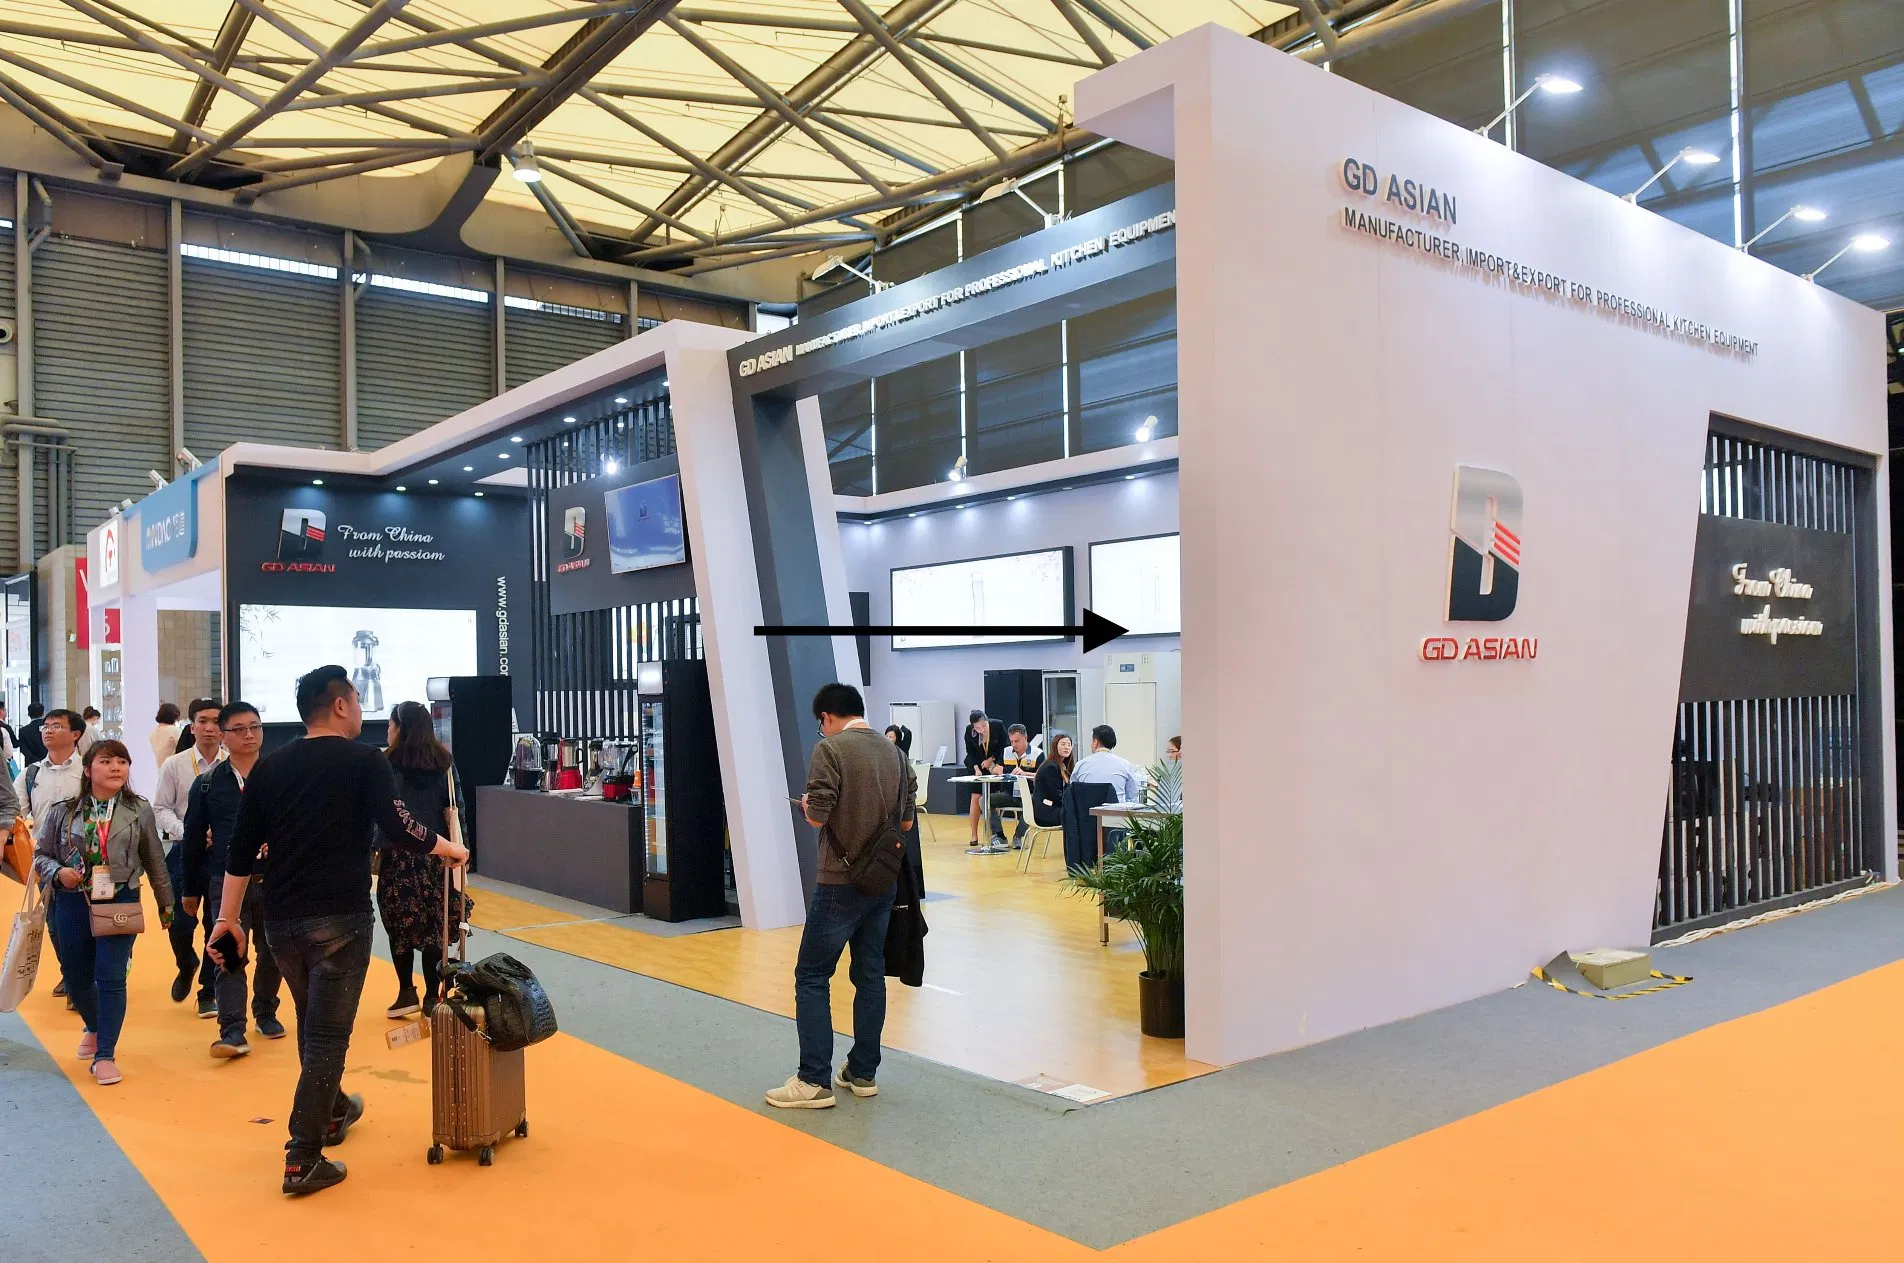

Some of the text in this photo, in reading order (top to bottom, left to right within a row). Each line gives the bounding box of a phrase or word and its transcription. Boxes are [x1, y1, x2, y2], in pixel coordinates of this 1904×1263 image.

[1343, 157, 1457, 225] GD ASIAN
[739, 358, 757, 377] GD
[757, 344, 794, 371] ASIAN
[940, 286, 964, 306] FOR
[964, 258, 1047, 297] PROFESSIONAL
[1050, 237, 1106, 268] KITCHEN
[1109, 209, 1176, 246] EQUIPMEN
[1571, 281, 1592, 304] FOR
[1596, 289, 1671, 329] PROFESSIONAL
[1673, 315, 1711, 342] KITCHEN
[1713, 329, 1759, 357] EQUIPMENT
[384, 526, 434, 543] China
[348, 544, 384, 559] with
[261, 562, 337, 573] GD ASIAN
[1421, 637, 1538, 661] GD ASIAN
